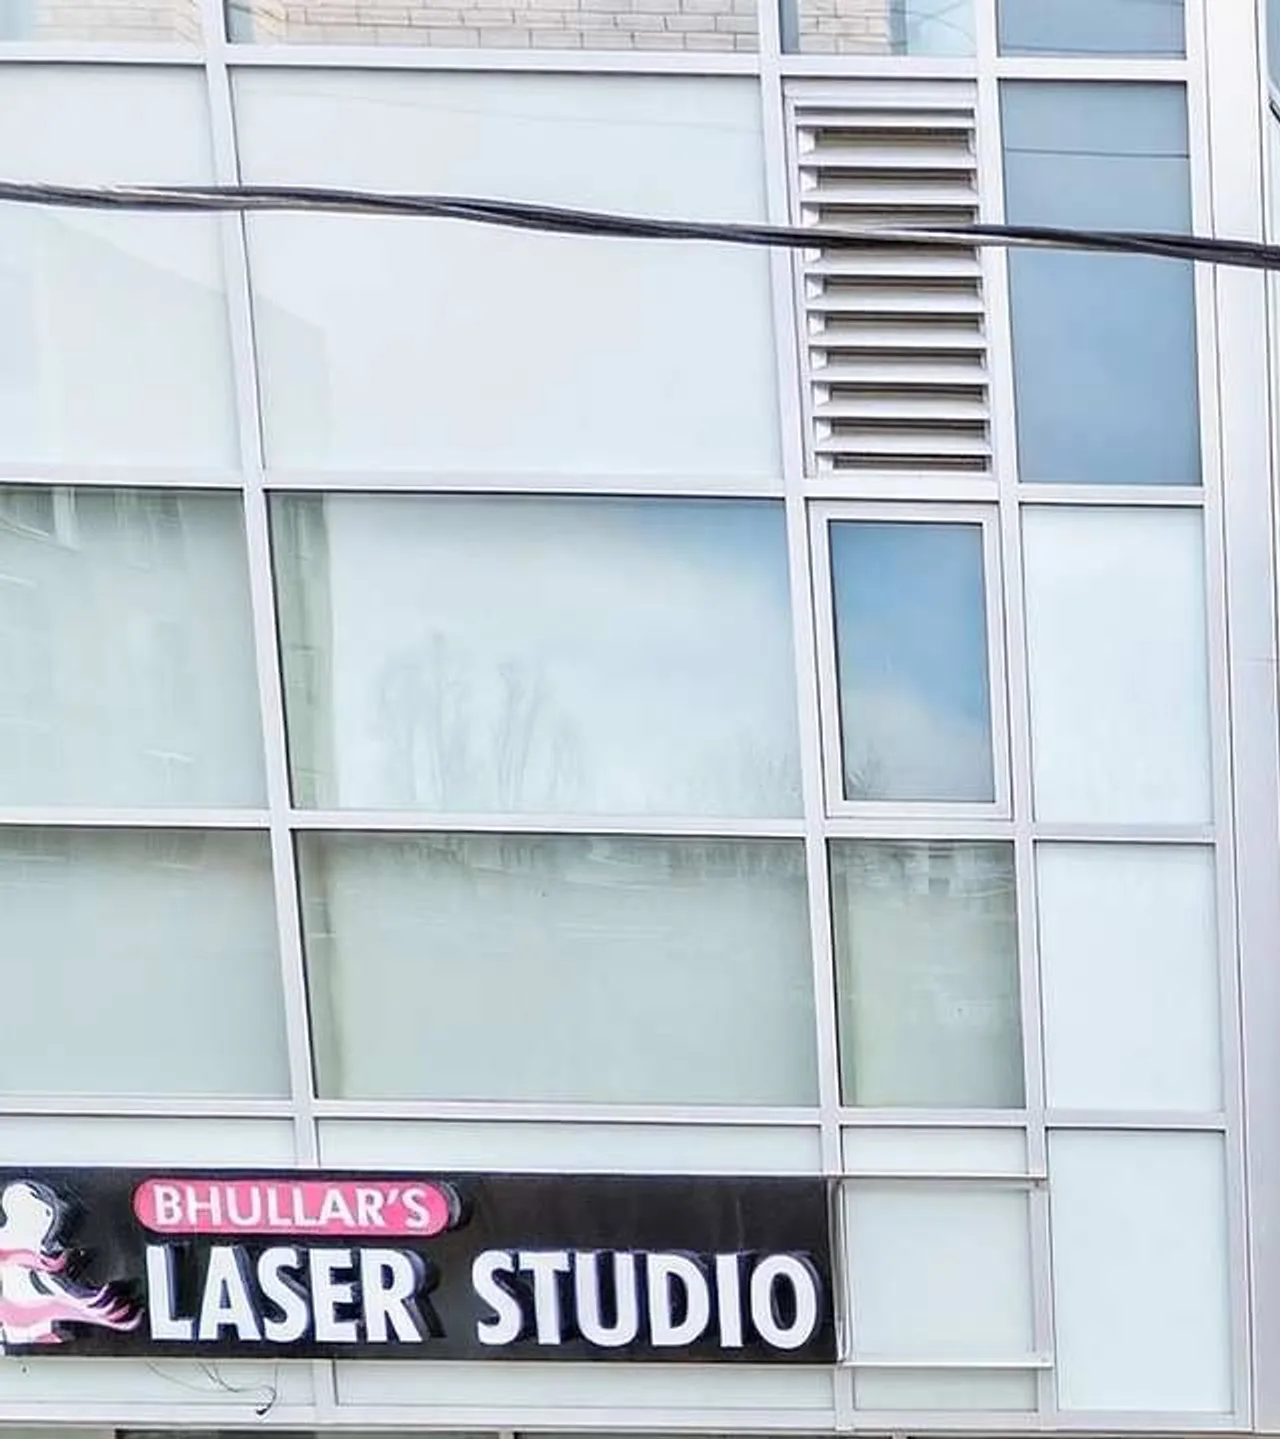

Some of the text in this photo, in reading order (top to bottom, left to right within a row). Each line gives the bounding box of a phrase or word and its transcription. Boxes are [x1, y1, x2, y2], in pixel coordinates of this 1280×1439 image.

[152, 1186, 432, 1230] BHULLAR'S
[145, 1244, 818, 1350] LASER STUDIO
